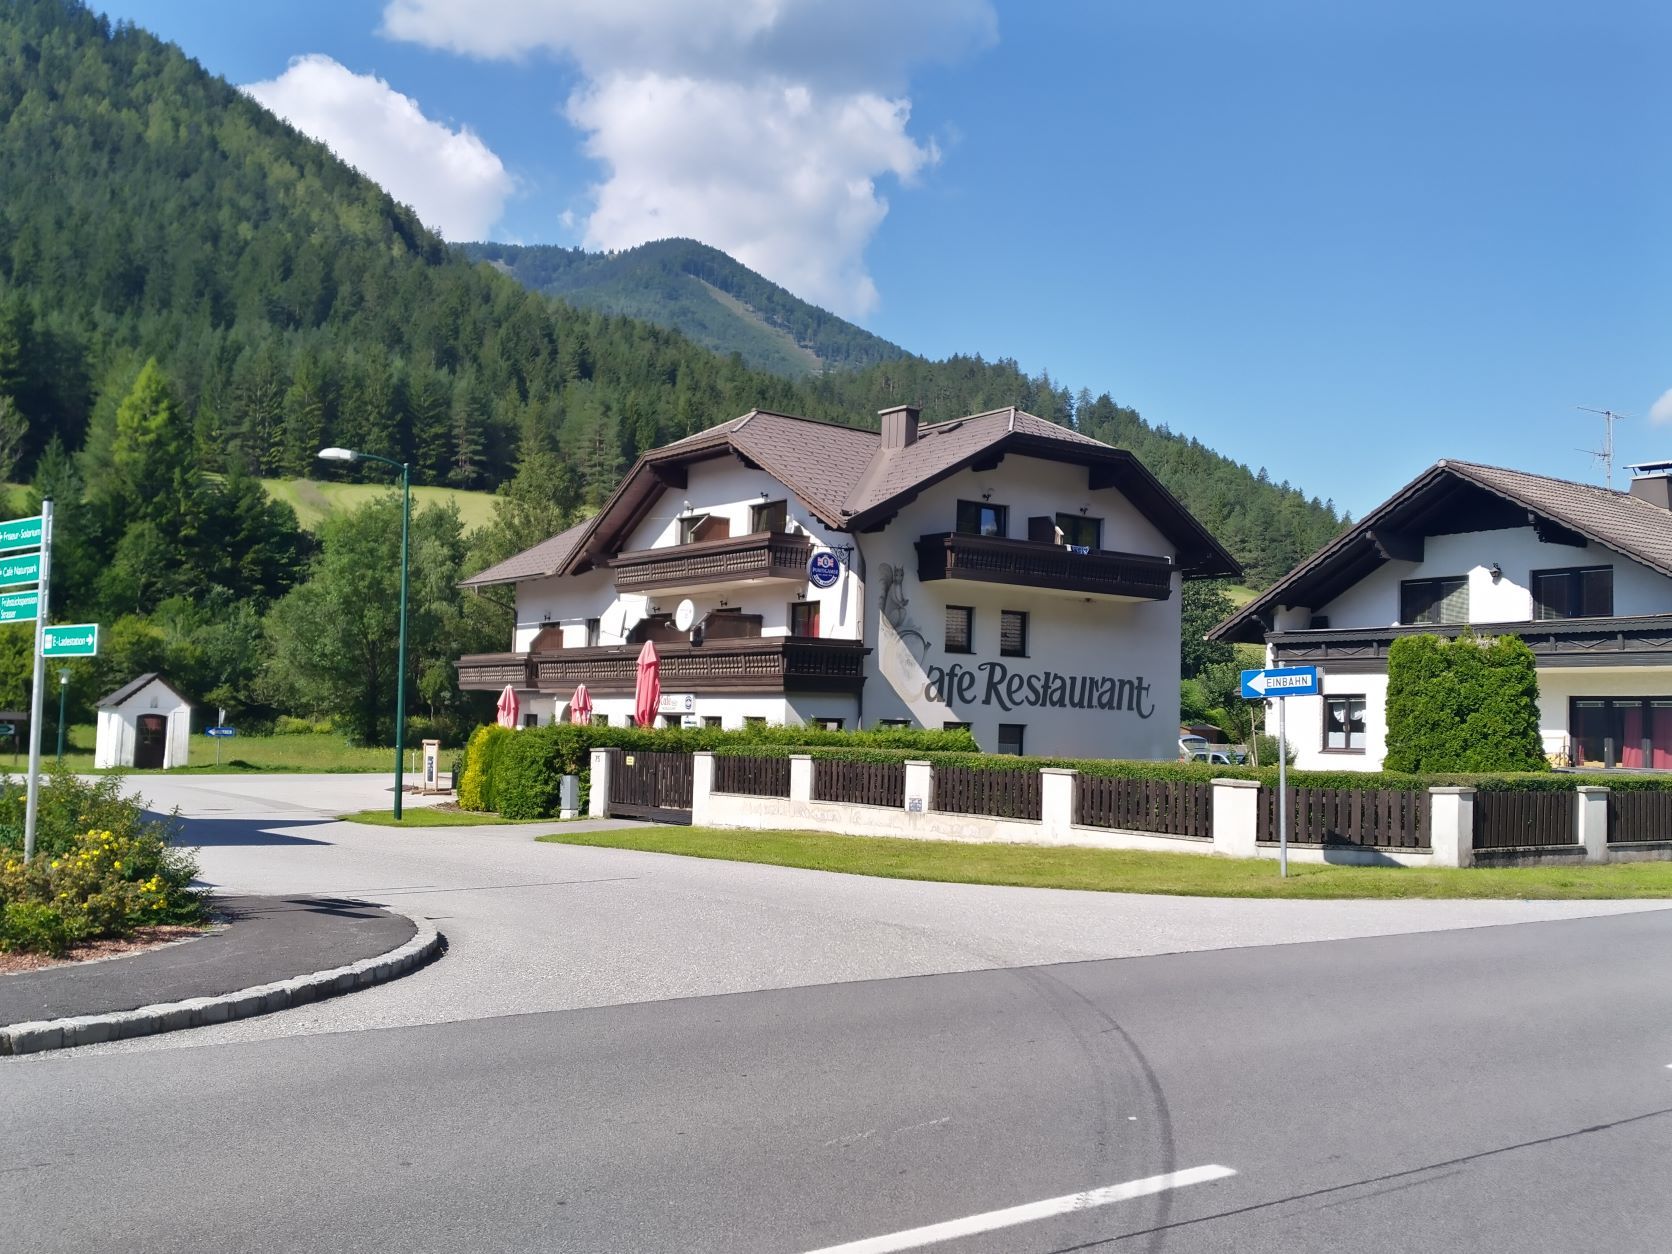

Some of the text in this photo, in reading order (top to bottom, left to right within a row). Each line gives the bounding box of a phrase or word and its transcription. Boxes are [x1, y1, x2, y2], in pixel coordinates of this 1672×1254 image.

[14, 564, 36, 577] Naturpark
[1266, 676, 1308, 687] EINBAHN
[978, 661, 1155, 719] Restaurant
